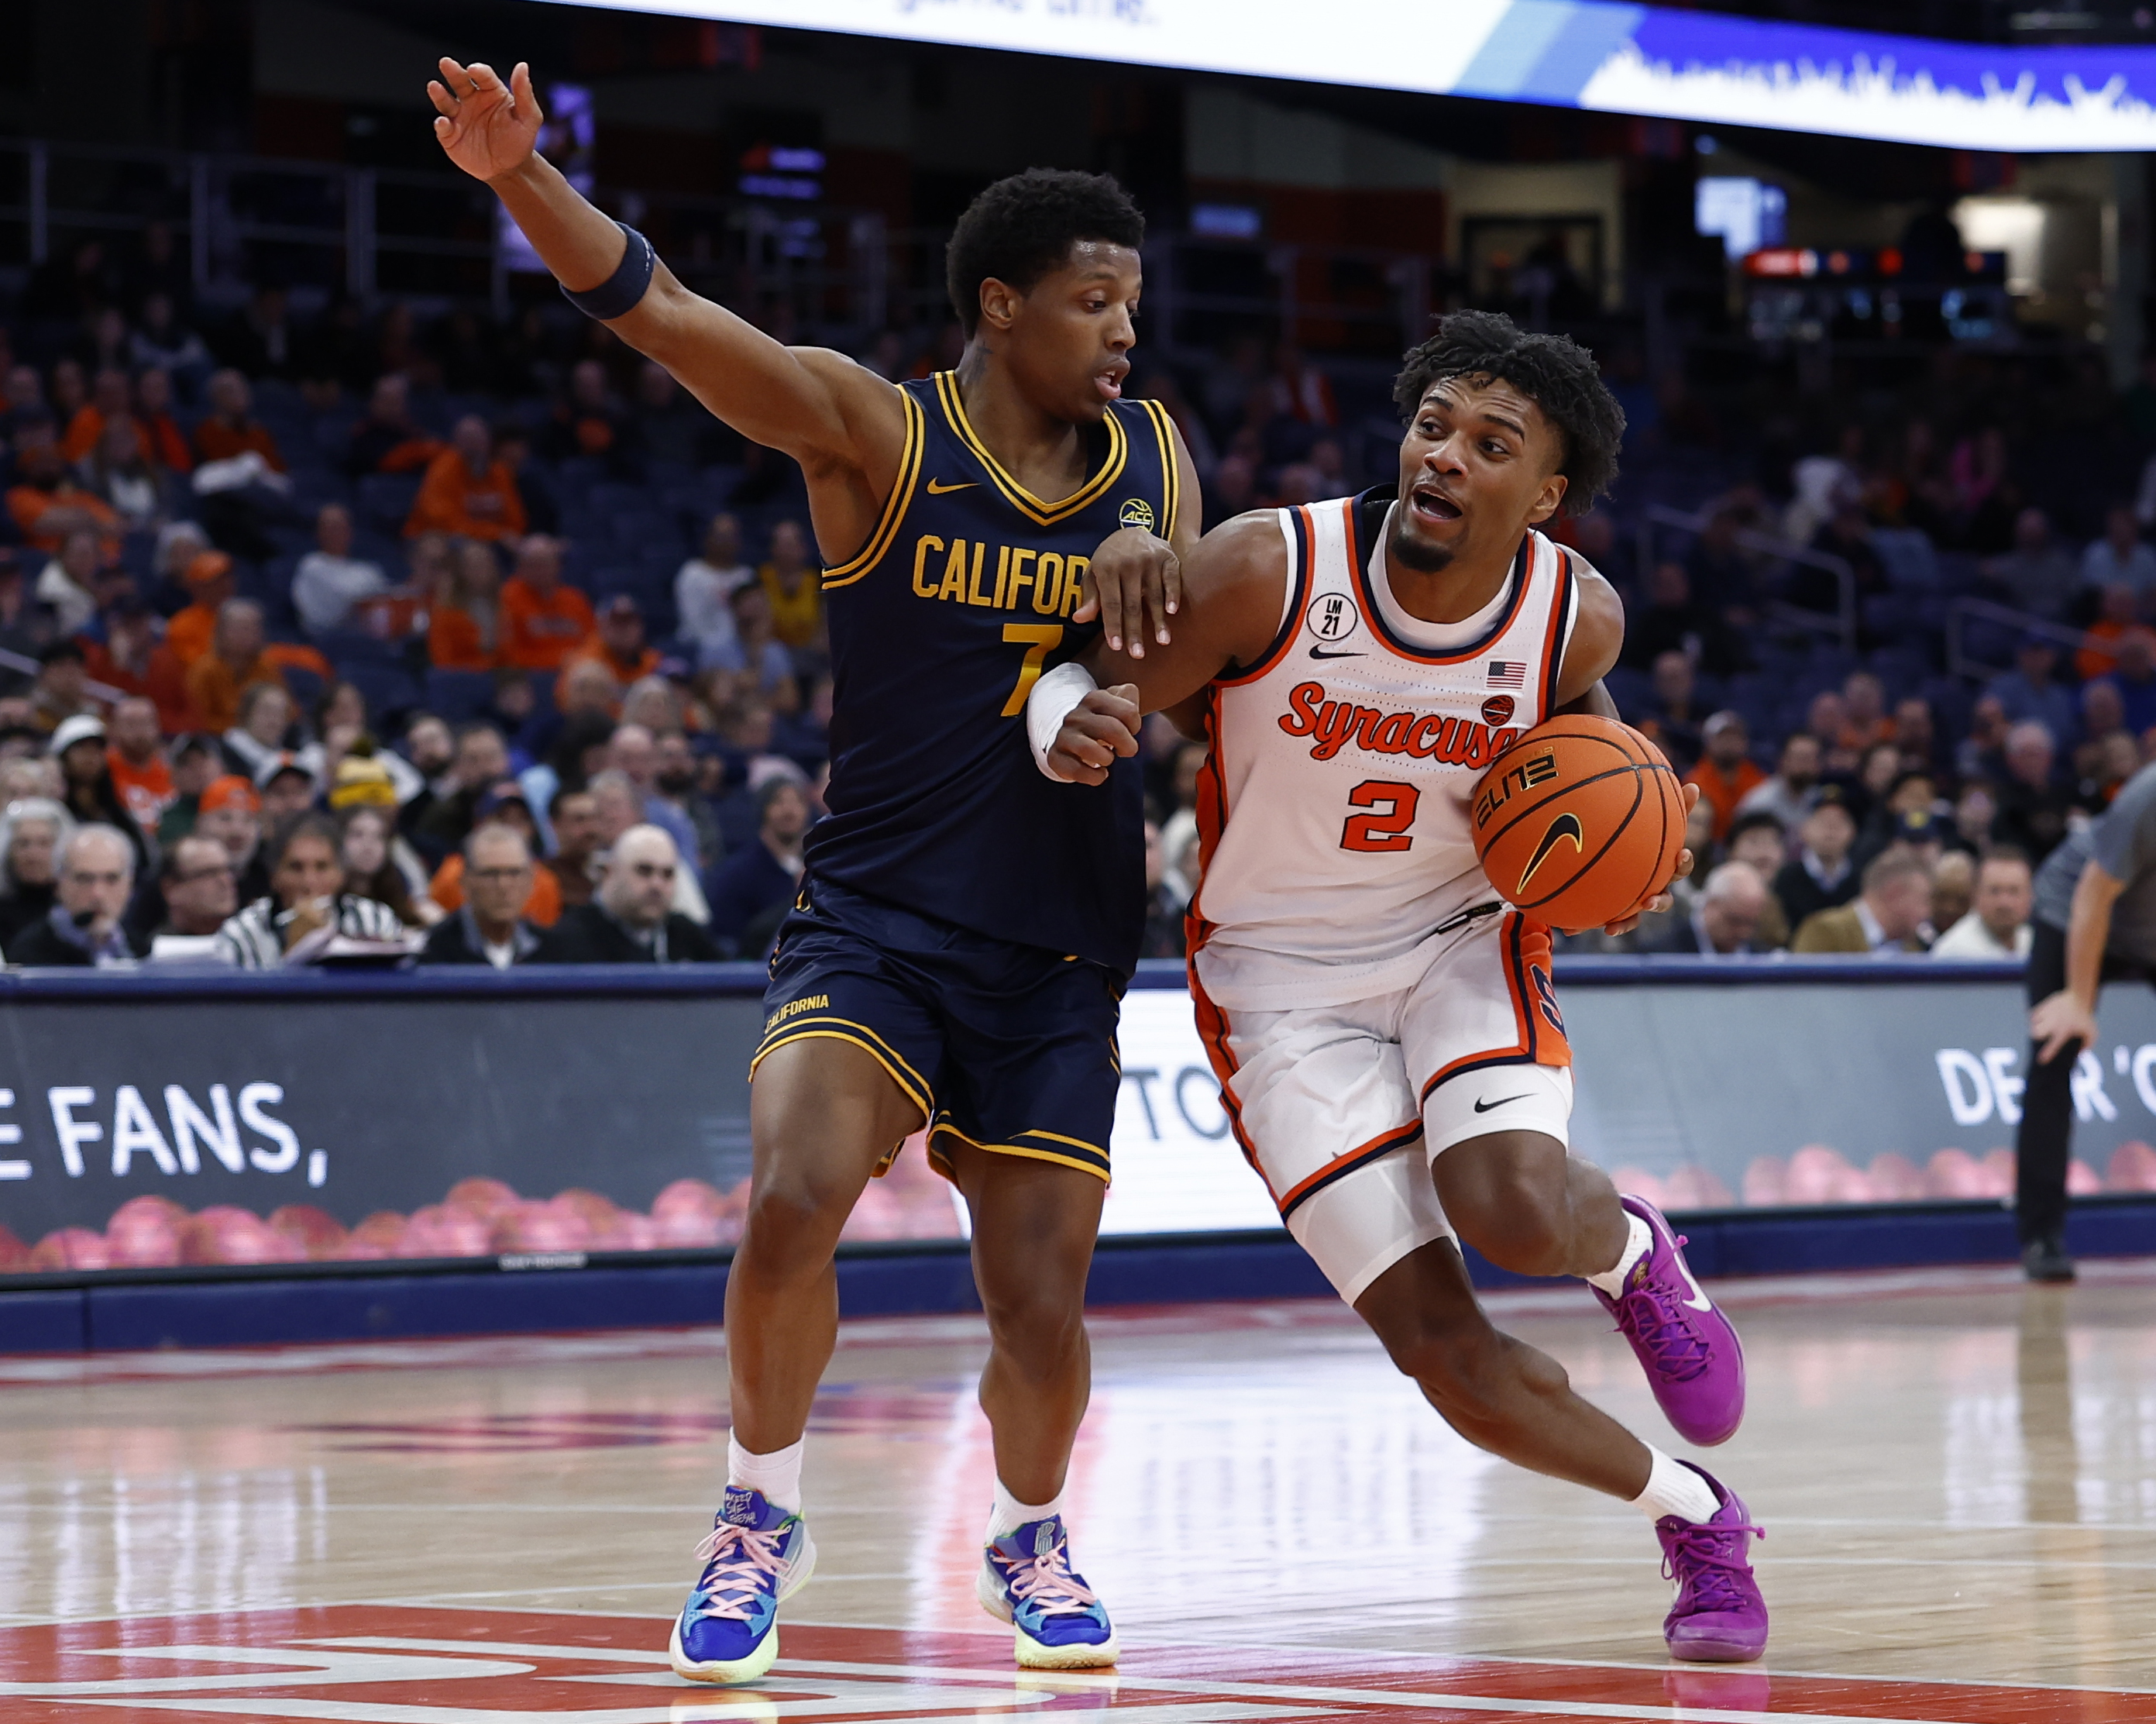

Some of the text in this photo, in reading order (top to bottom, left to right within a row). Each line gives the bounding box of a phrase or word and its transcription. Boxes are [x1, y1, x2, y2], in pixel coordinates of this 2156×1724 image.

[1123, 511, 1153, 522] ACC
[913, 535, 1089, 618] CALIFOR
[1326, 599, 1343, 614] LM
[1321, 614, 1339, 635] 21
[1001, 623, 1063, 717] 7
[1278, 681, 1518, 769] Syracuse
[1339, 779, 1421, 852] 2
[1475, 754, 1559, 831] ELITE
[764, 994, 829, 1034] CALIFORNIA
[1935, 1047, 2118, 1126] DER
[47, 1081, 328, 1187] FANS,
